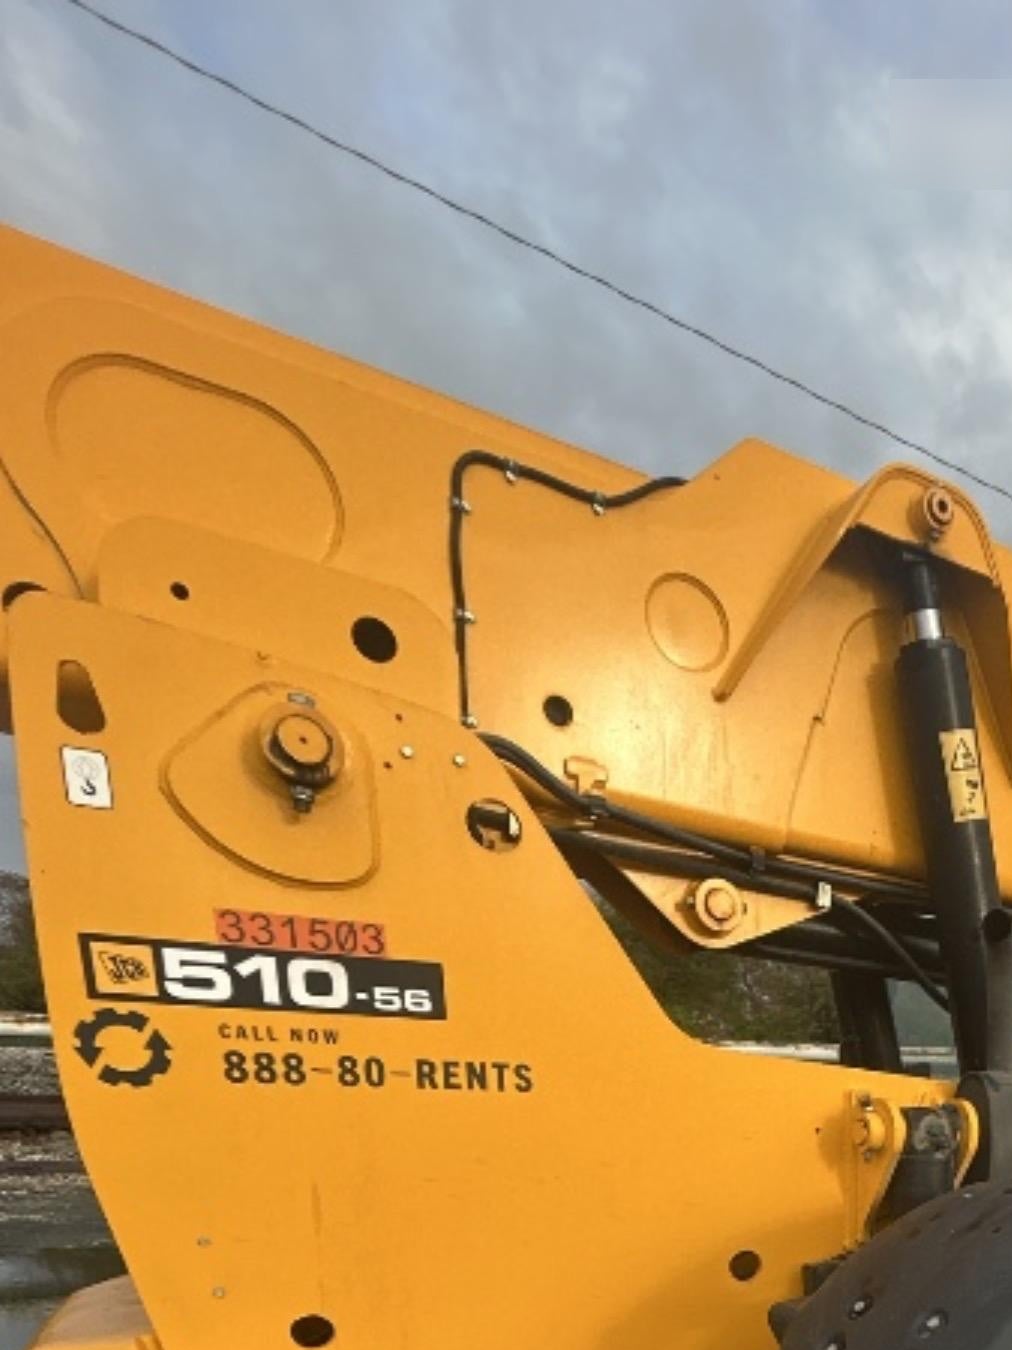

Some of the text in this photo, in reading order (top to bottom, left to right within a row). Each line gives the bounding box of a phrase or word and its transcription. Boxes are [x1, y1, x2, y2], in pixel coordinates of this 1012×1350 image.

[217, 908, 386, 955] 331503
[218, 1022, 340, 1045] CALL NOW
[223, 1049, 533, 1093] 888-80-RENTS
